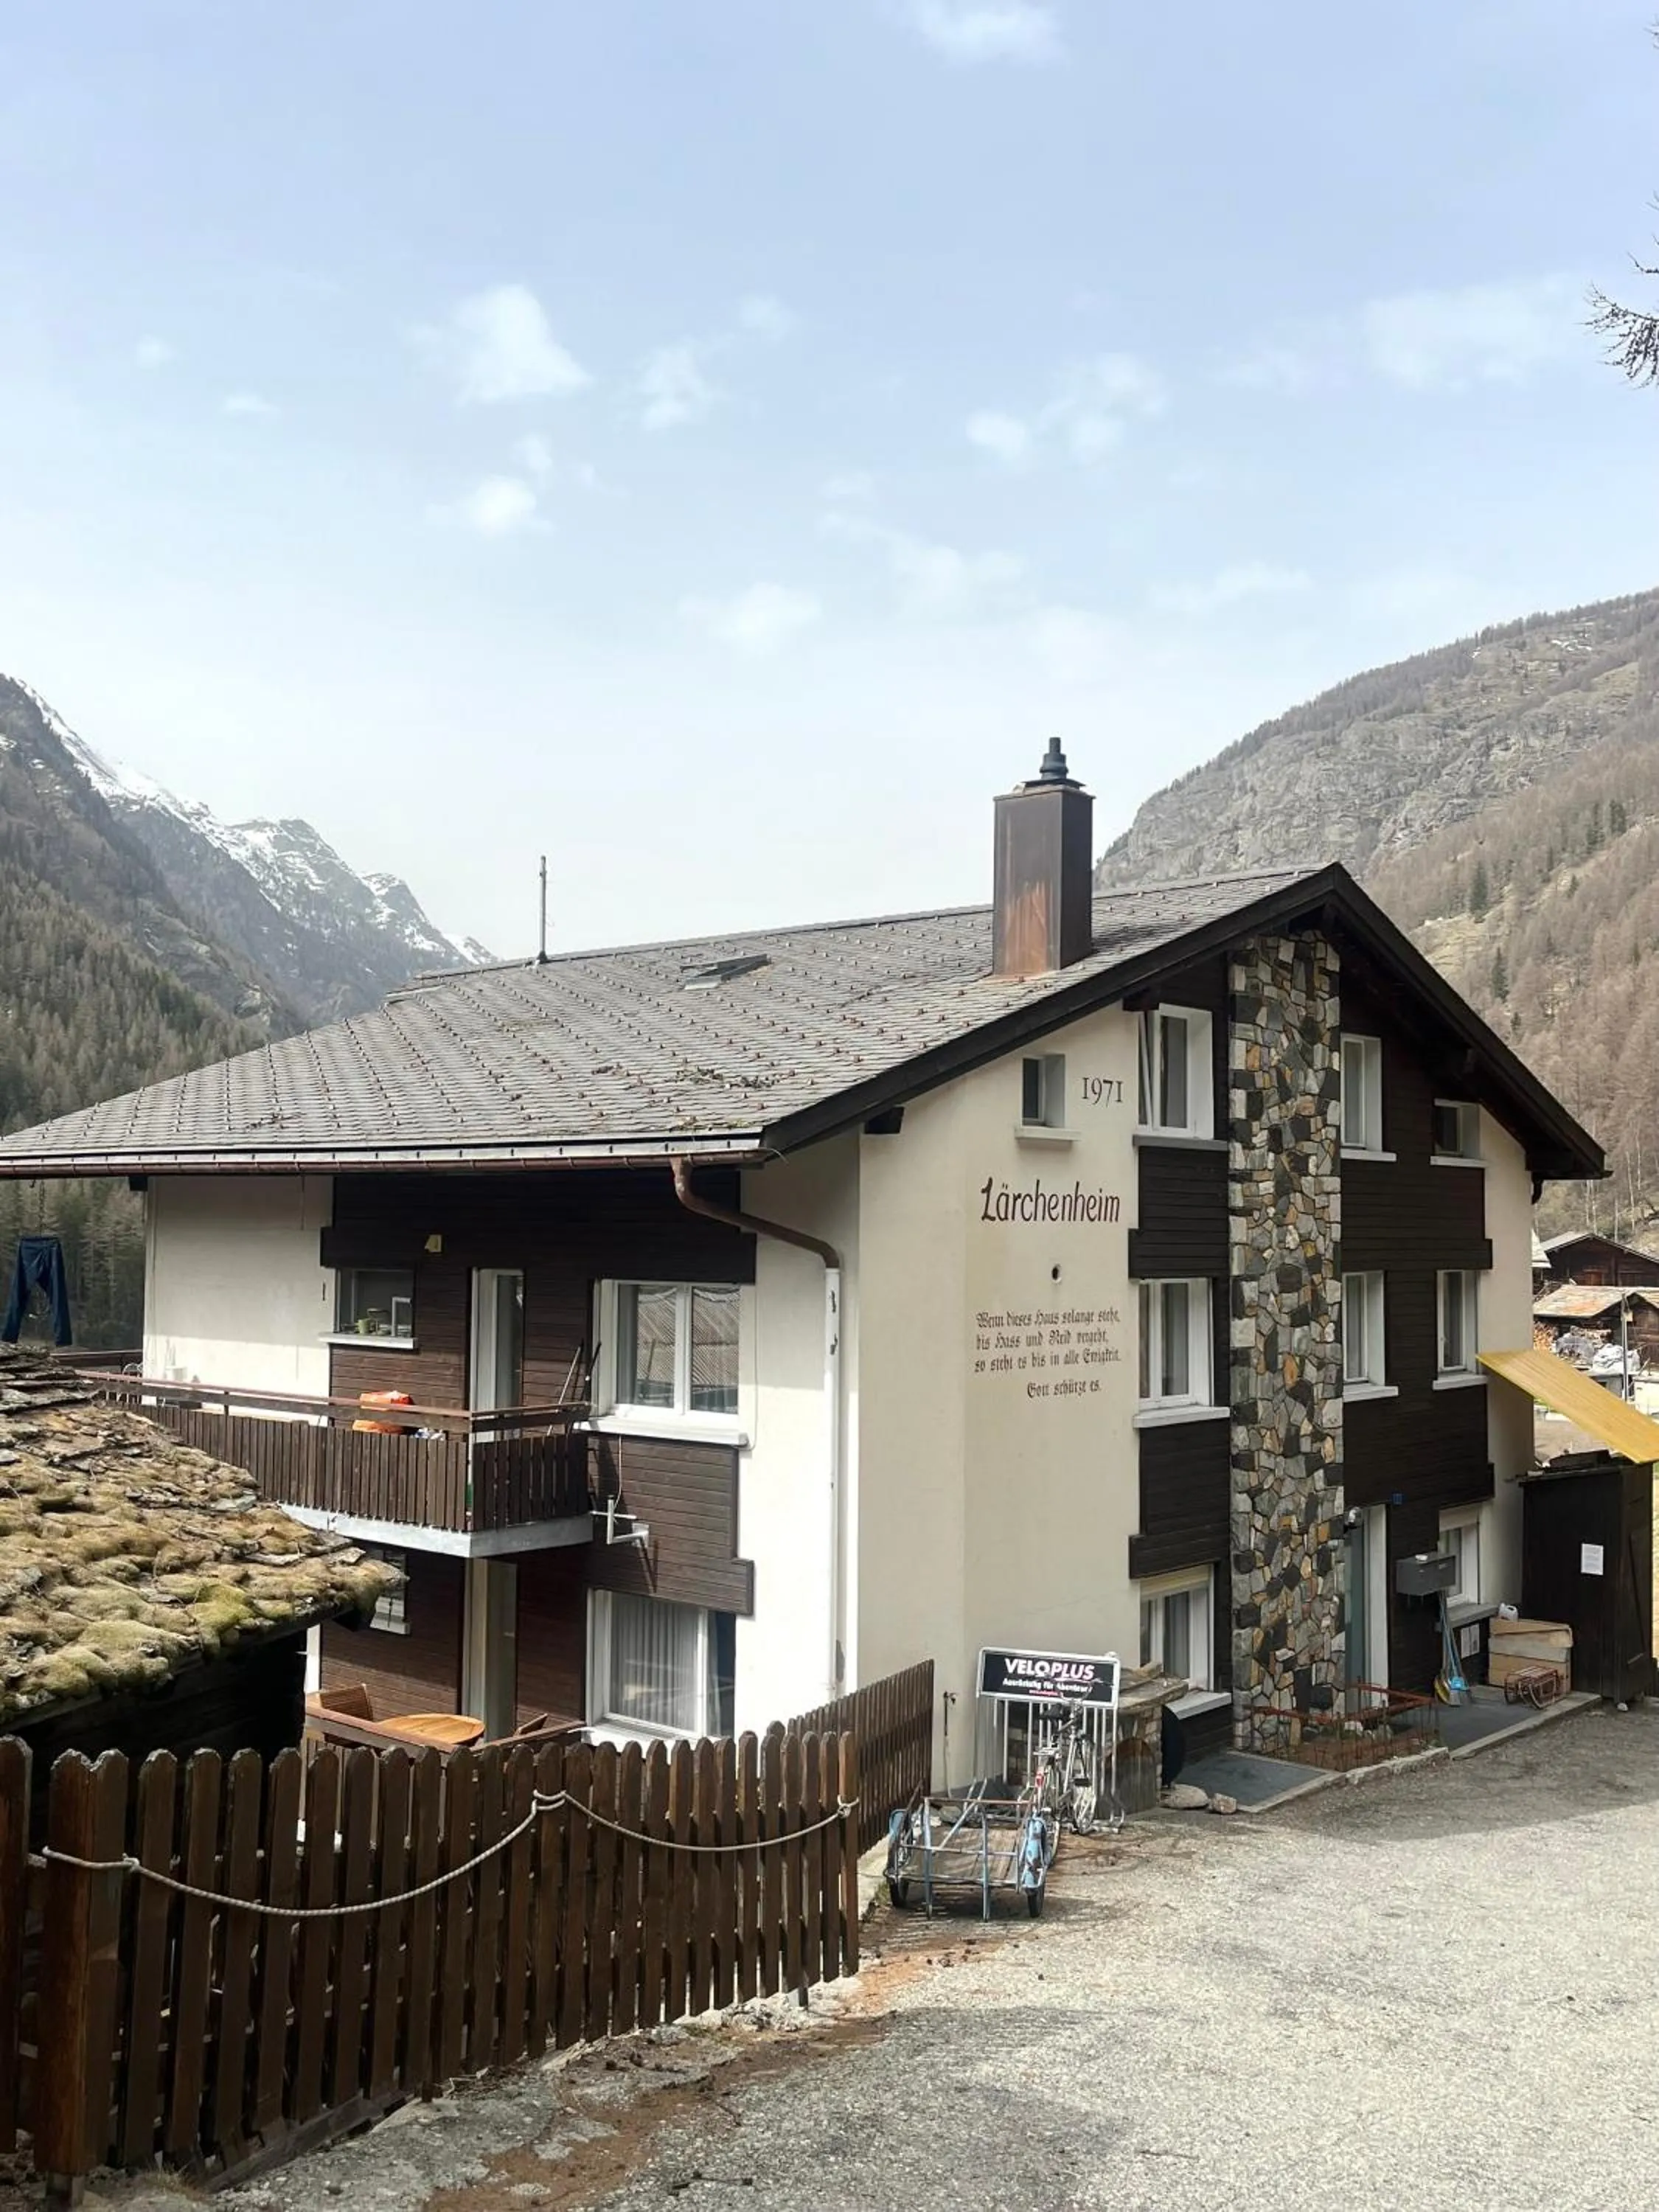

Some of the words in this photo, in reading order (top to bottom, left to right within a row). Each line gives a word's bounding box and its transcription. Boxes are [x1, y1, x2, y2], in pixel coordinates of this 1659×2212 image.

[1082, 1077, 1123, 1107] 1971
[981, 1177, 1121, 1222] Lärchenheim
[976, 1312, 1004, 1328] Wenn
[1034, 1310, 1060, 1326] Haus
[1026, 1331, 1043, 1347] und
[975, 1359, 986, 1373] so
[1032, 1352, 1046, 1368] bis
[1050, 1351, 1060, 1366] in
[1005, 1658, 1095, 1680] VELOPLUS
